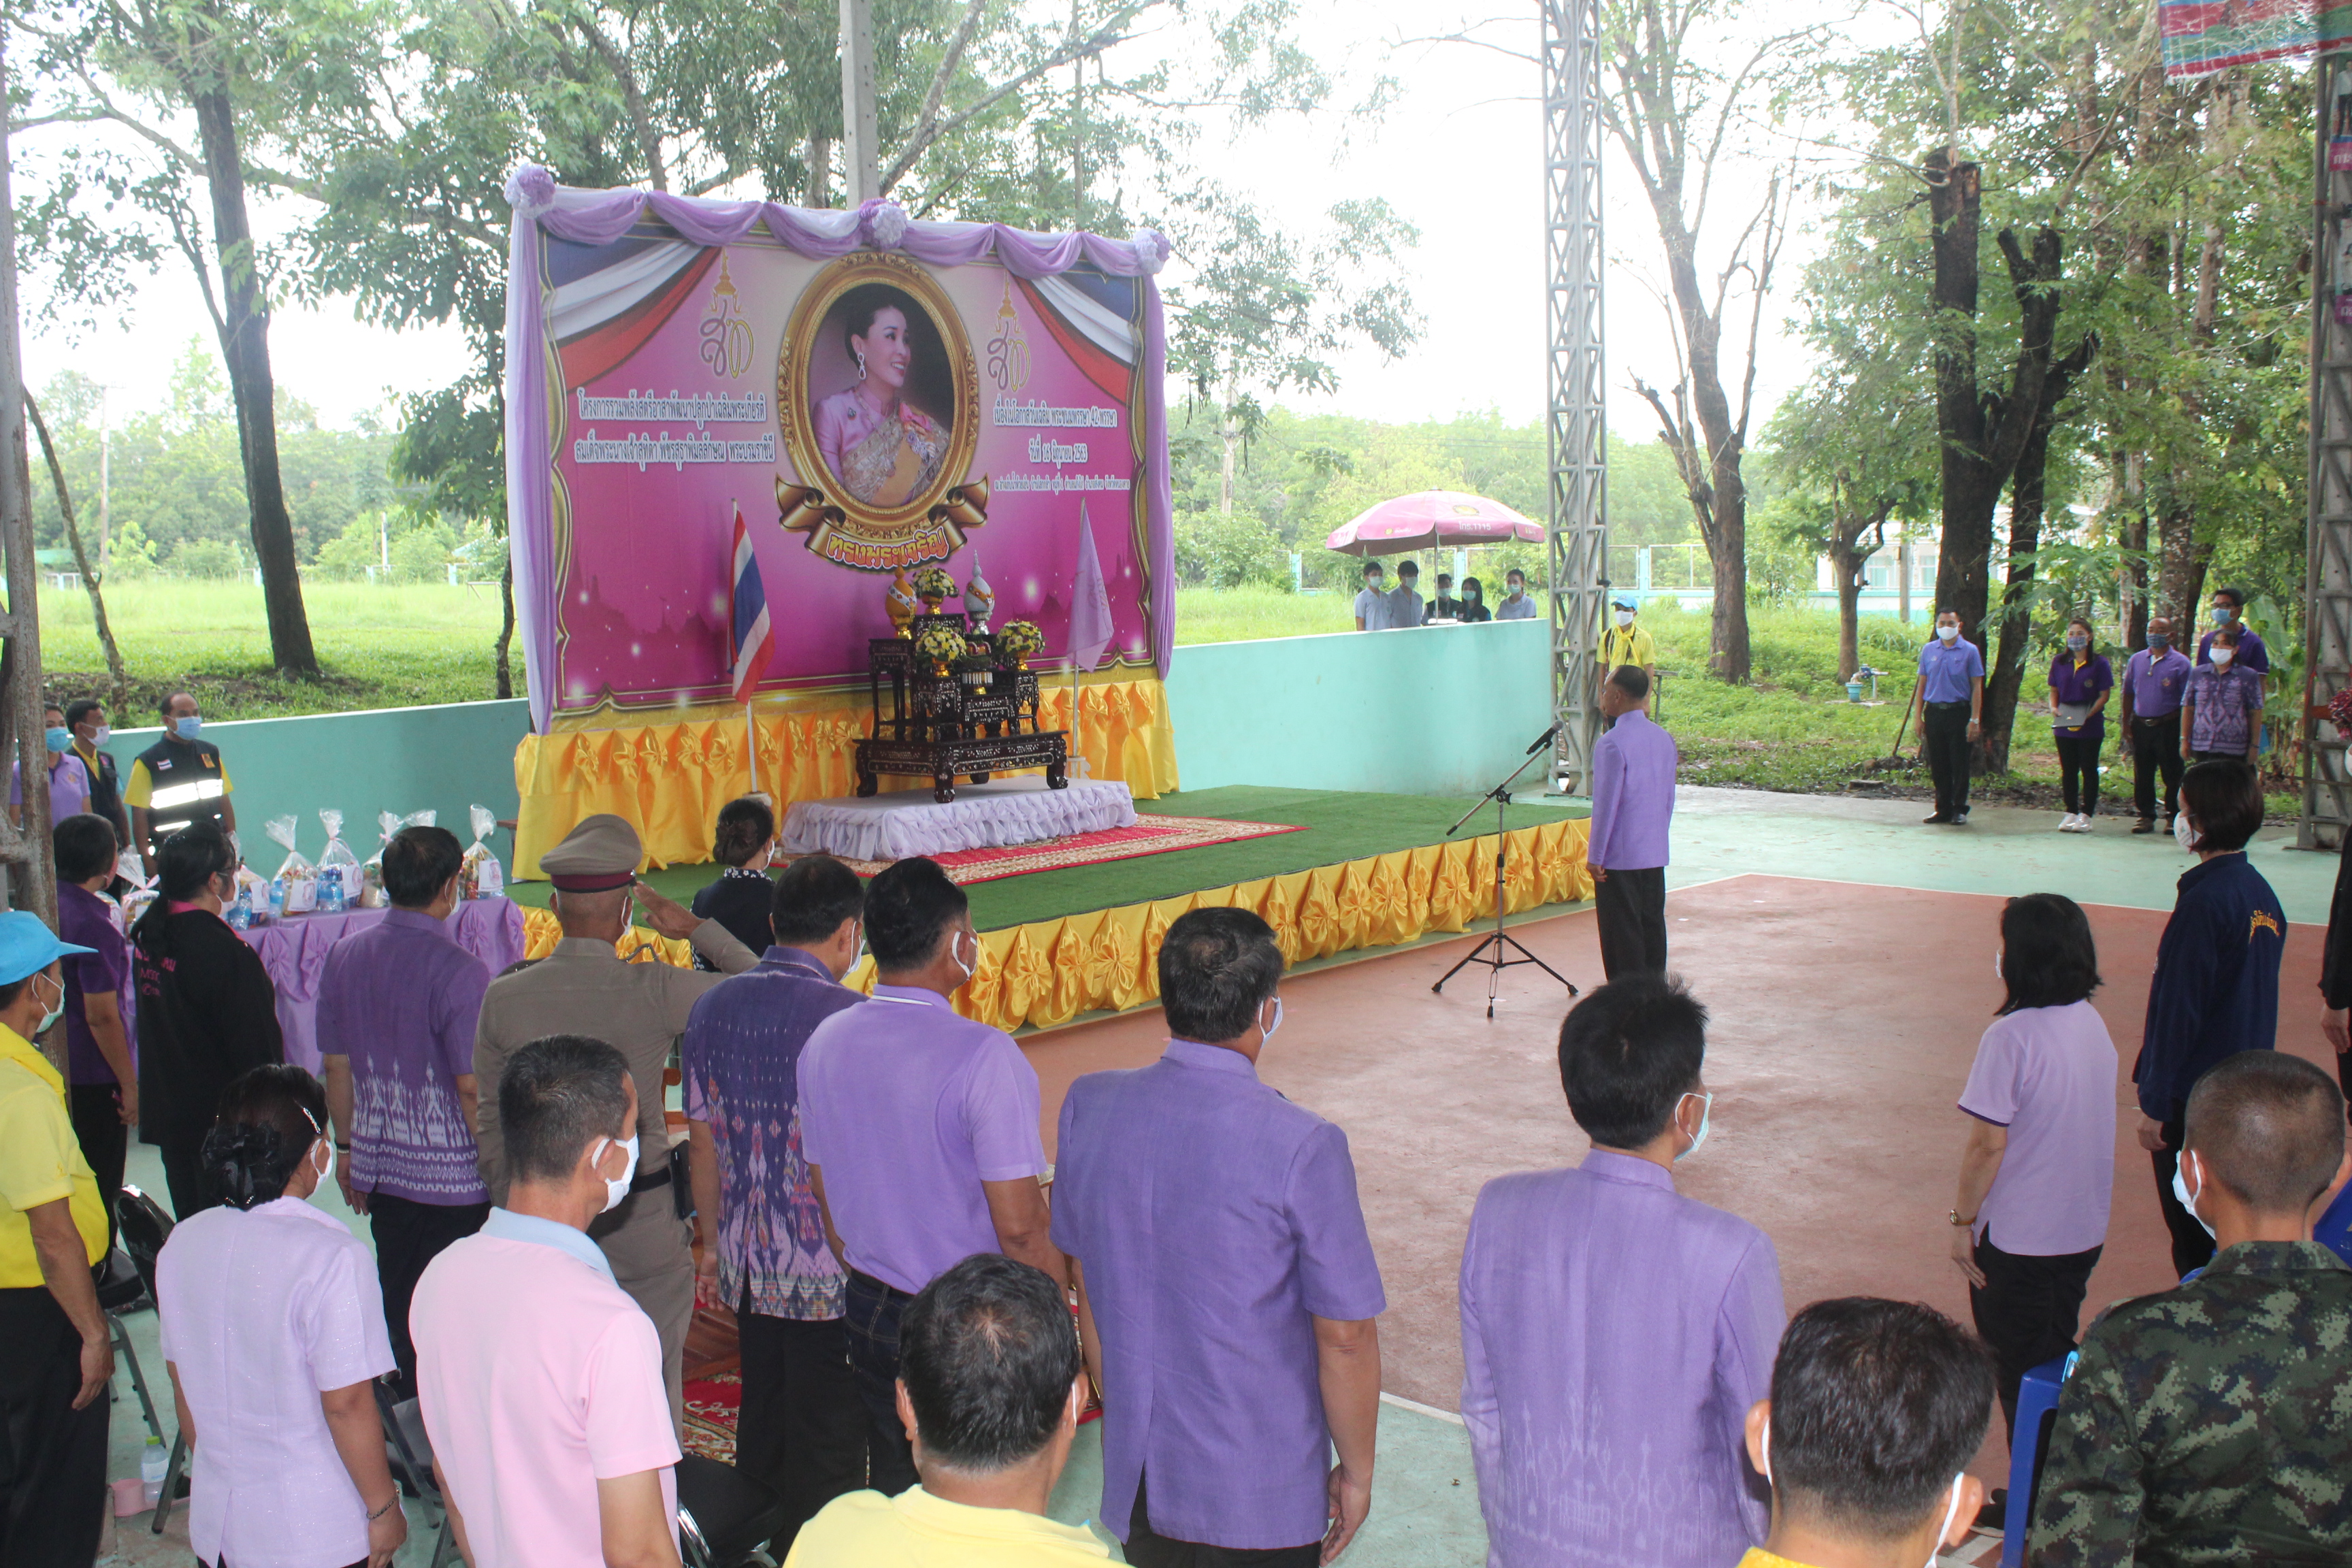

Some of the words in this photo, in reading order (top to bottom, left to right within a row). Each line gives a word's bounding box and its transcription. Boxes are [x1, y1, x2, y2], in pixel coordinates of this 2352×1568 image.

[1091, 406, 1099, 427] 42
[728, 432, 775, 462] พระบรมราชินี
[1028, 434, 1041, 463] วันที่
[1042, 443, 1051, 463] 16
[1051, 439, 1073, 470] มิถุนายน
[1073, 443, 1088, 463] 2563
[826, 526, 949, 570] ทรงพระเจริญ
